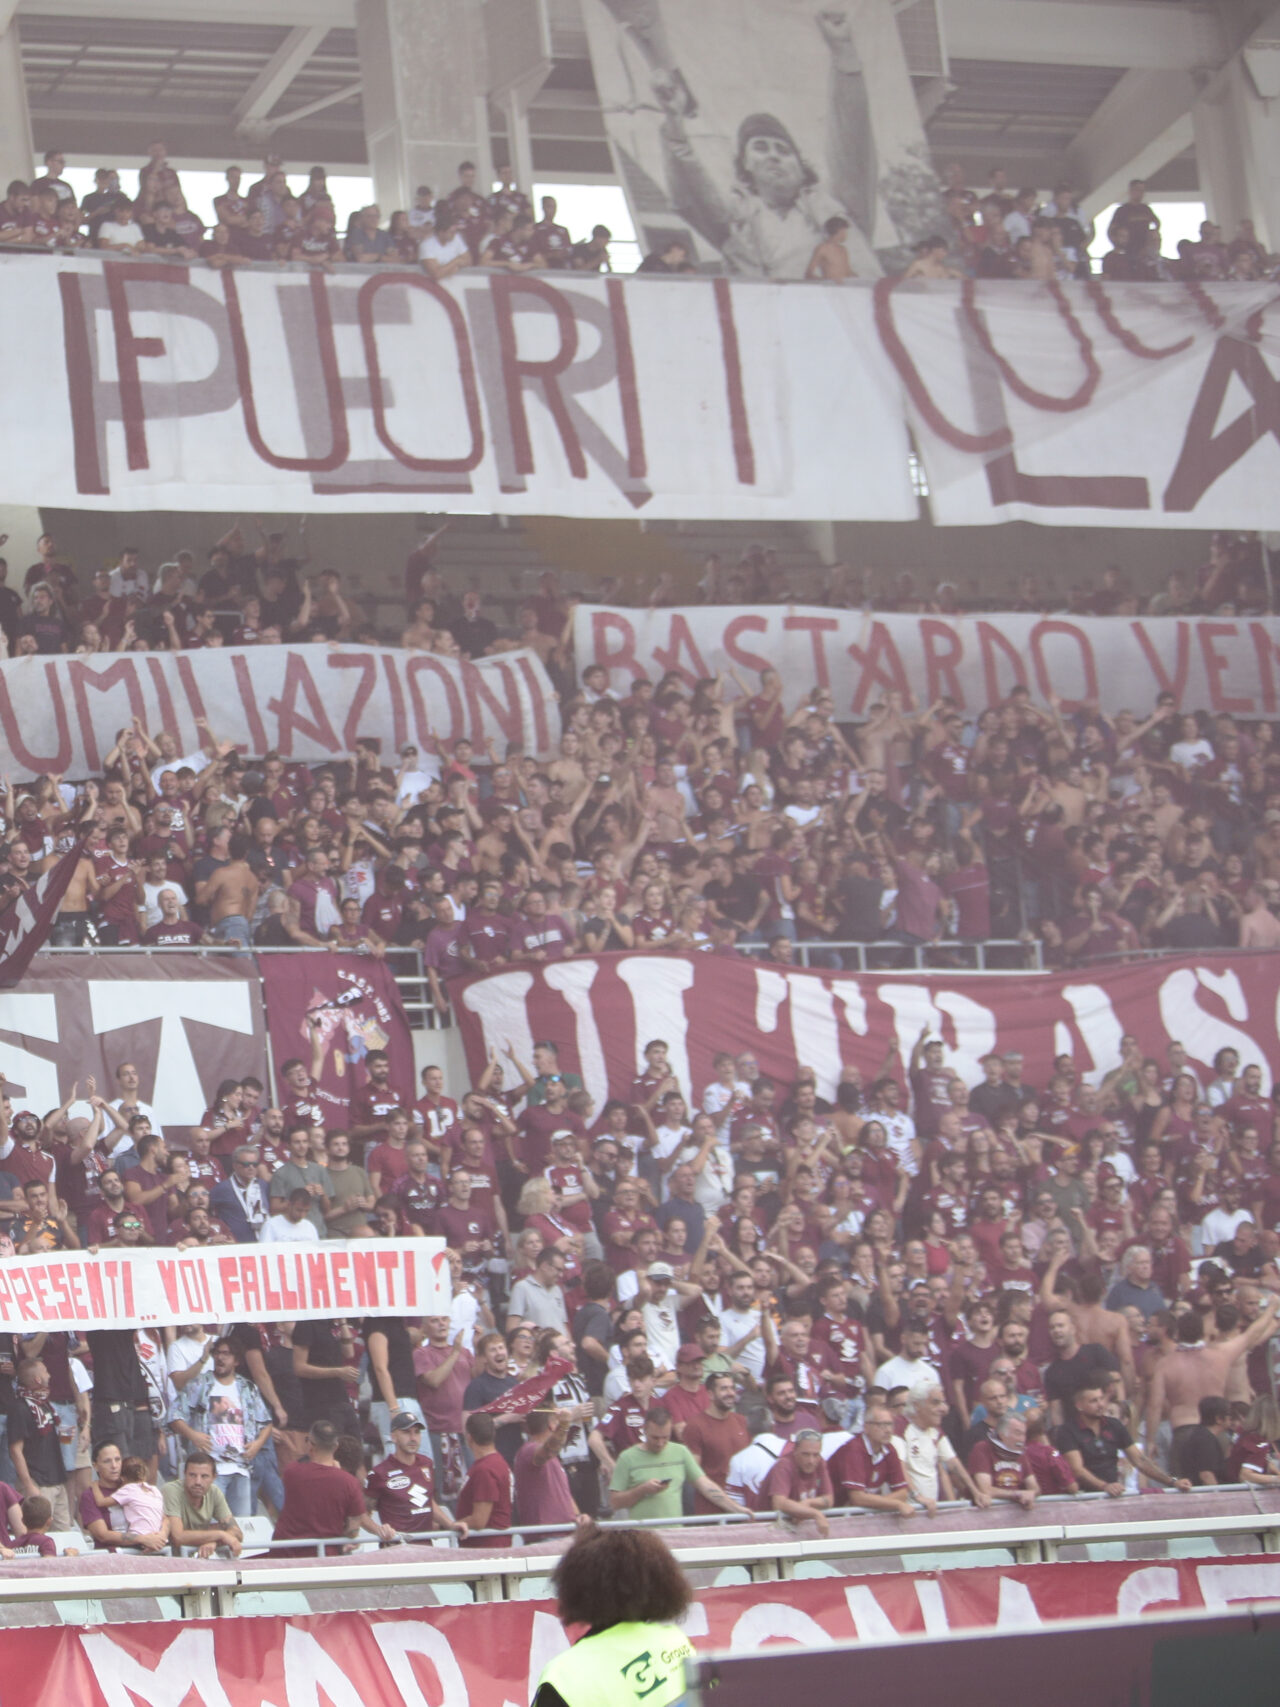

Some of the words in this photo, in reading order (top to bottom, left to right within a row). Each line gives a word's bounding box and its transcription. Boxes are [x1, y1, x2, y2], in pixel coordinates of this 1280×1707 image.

[591, 612, 1100, 714] BASTARDO
[463, 957, 1272, 1128] ULTRAS
[156, 1259, 213, 1314] VOI
